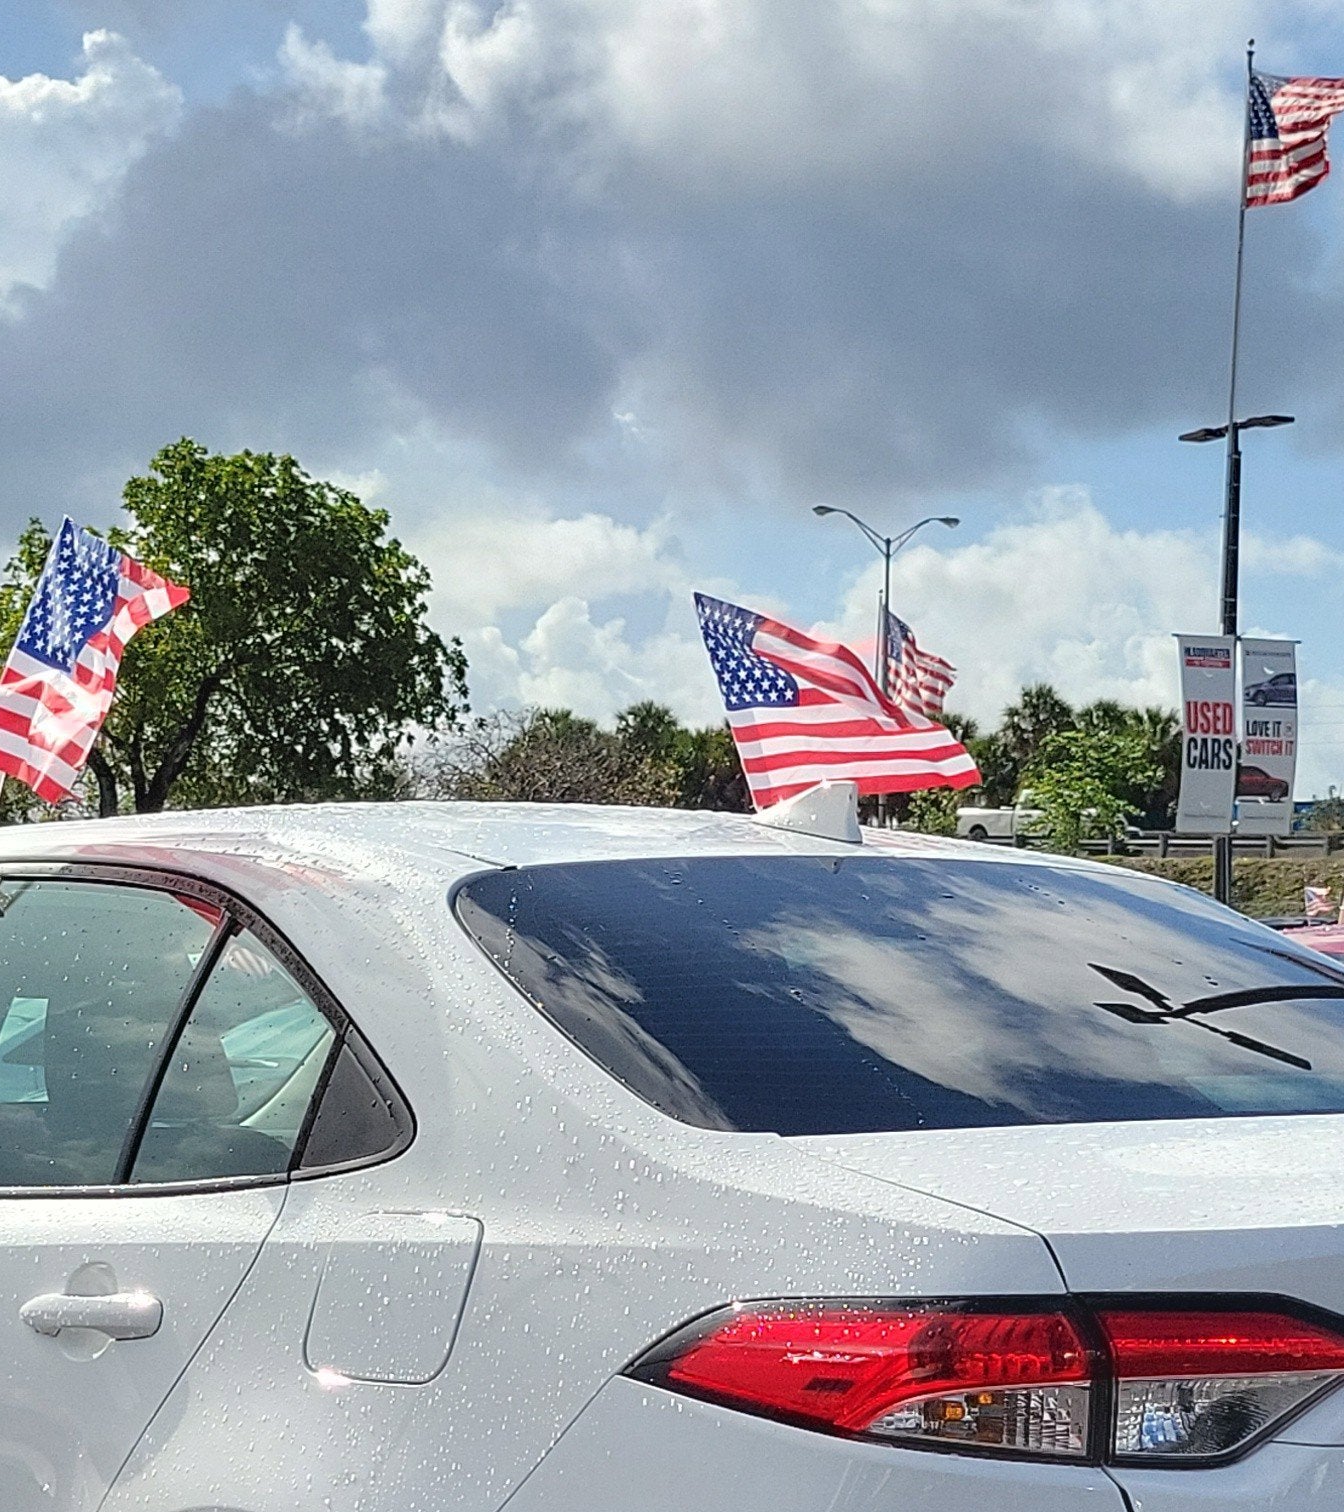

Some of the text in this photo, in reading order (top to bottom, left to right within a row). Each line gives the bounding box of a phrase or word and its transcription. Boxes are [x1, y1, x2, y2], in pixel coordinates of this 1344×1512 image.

[1185, 701, 1233, 735] USED
[1246, 720, 1270, 737] LOVE
[1272, 721, 1282, 738] IT
[1186, 736, 1233, 771] CARS
[1285, 740, 1294, 757] IT
